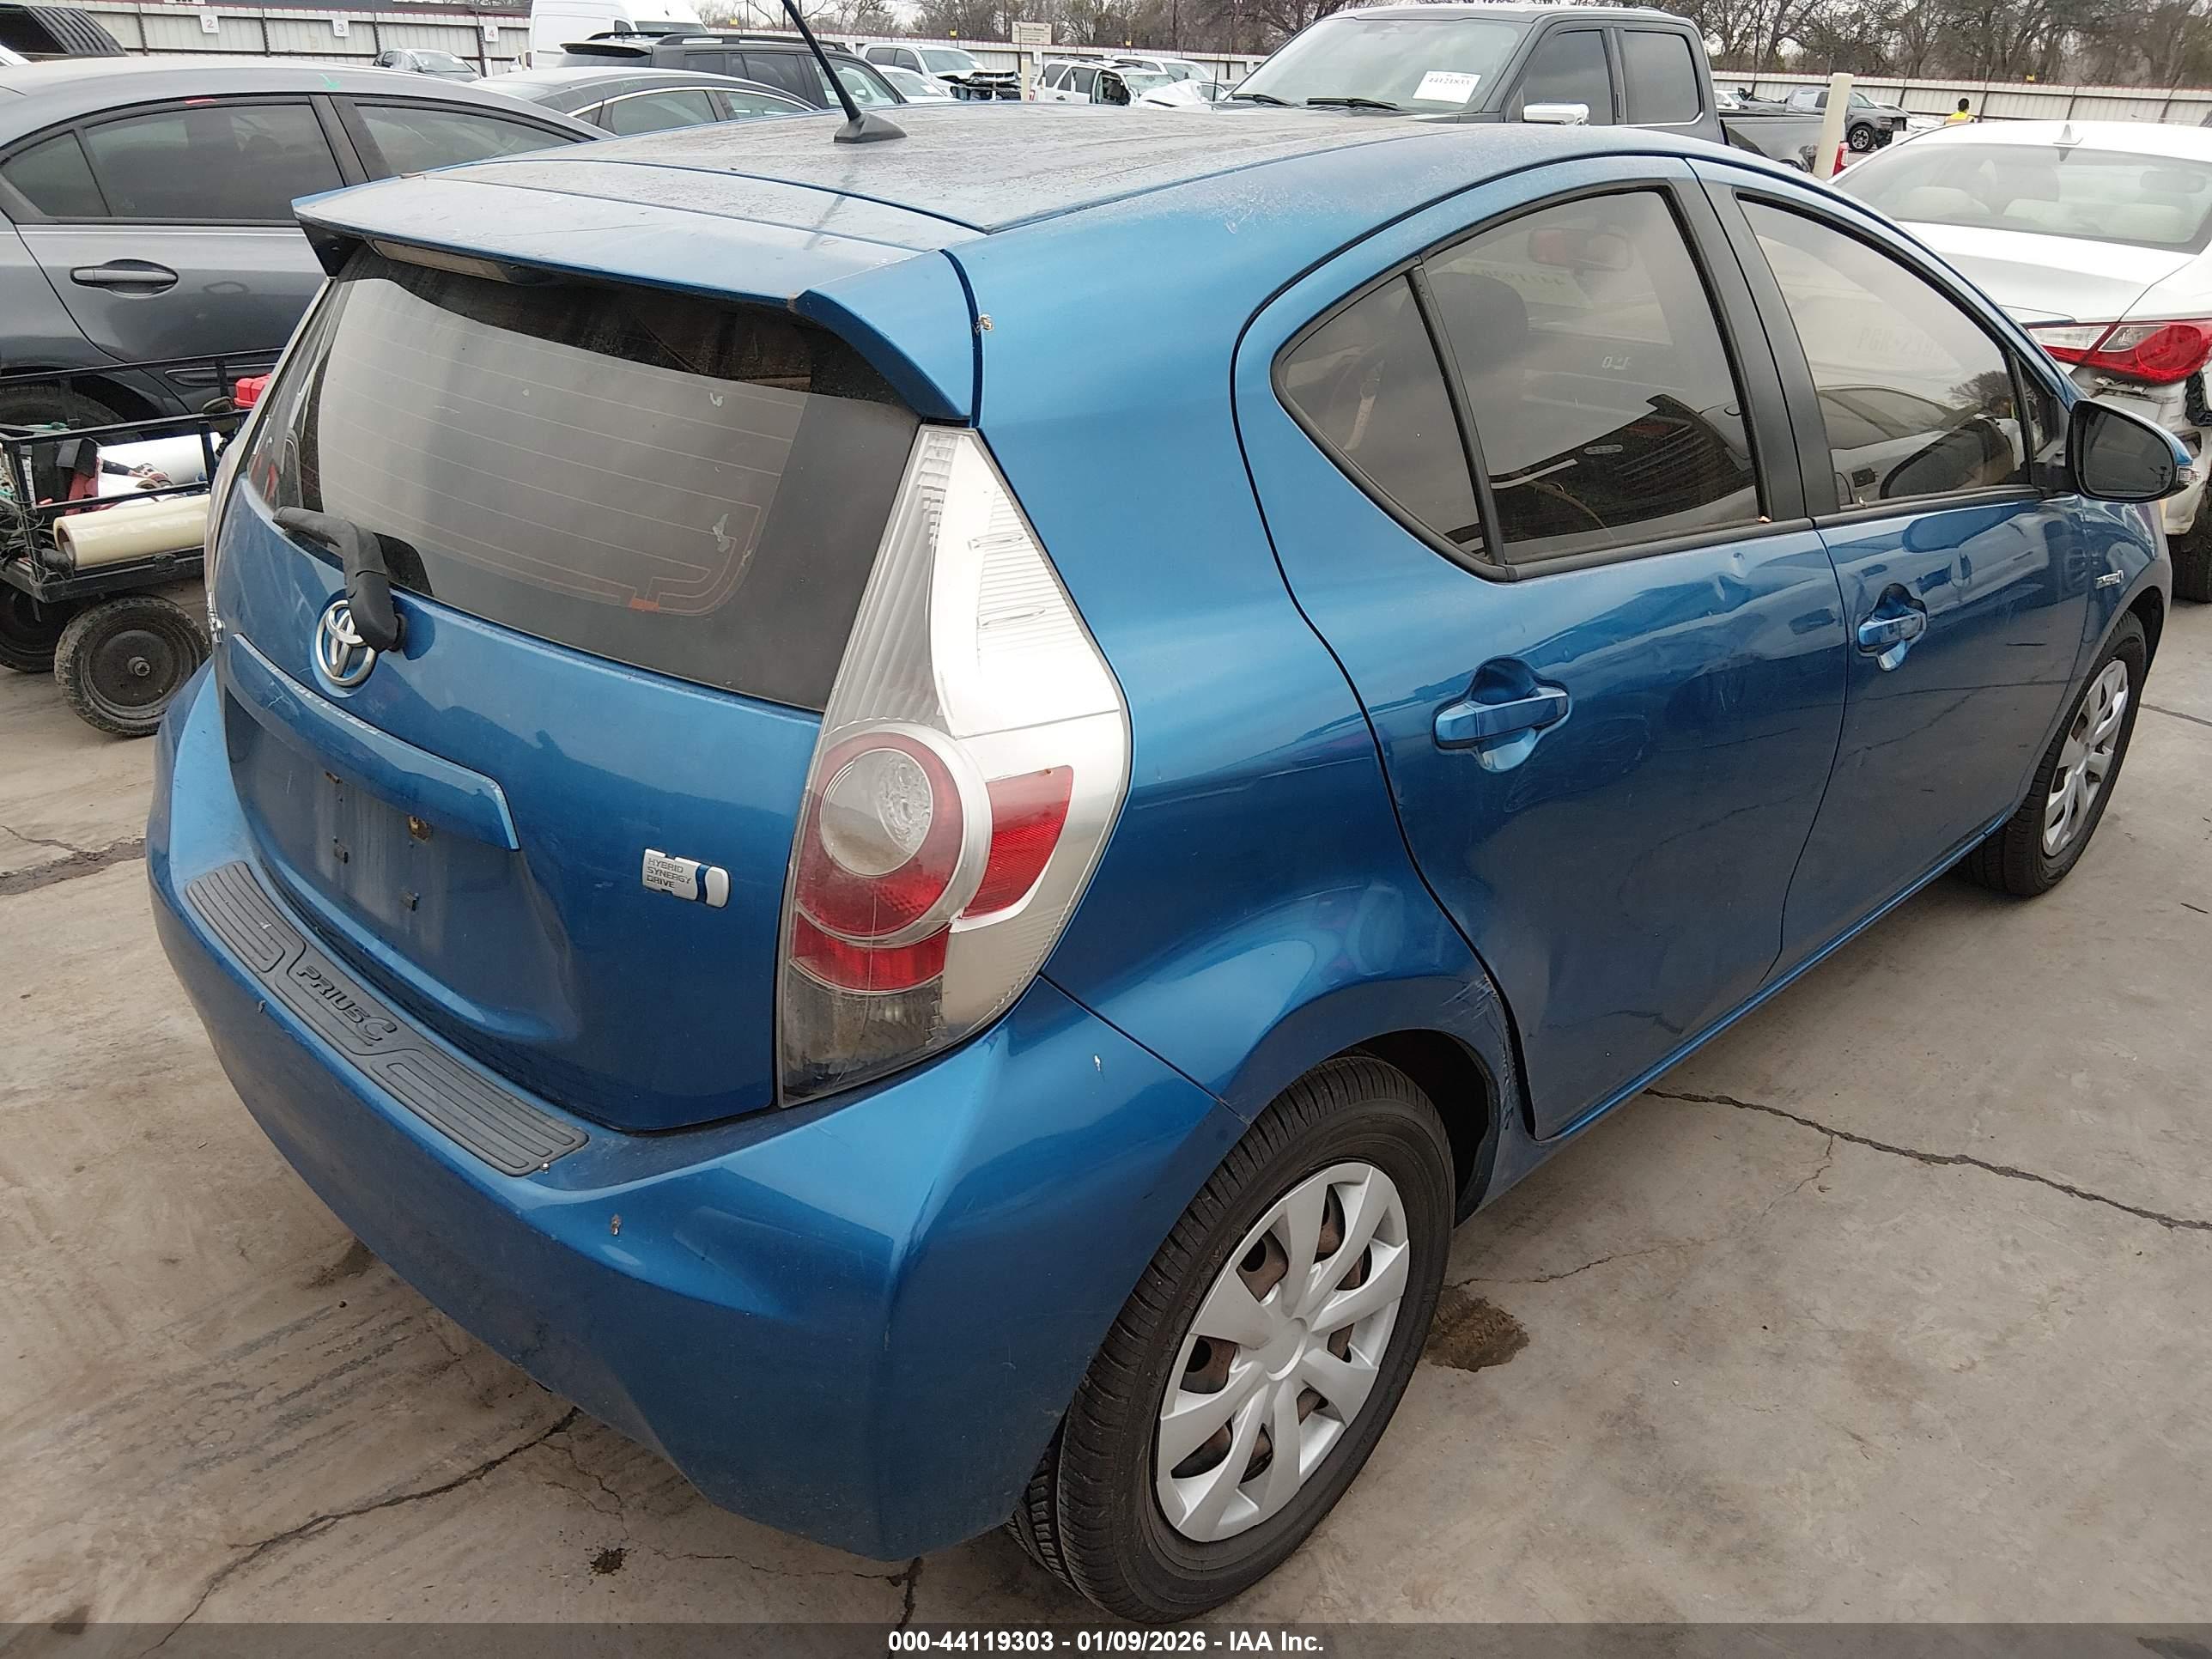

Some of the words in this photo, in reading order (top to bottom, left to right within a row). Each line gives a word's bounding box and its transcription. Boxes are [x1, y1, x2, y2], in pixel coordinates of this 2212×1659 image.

[206, 19, 215, 28] 2
[337, 23, 345, 33] 3
[488, 29, 495, 39] 4
[648, 857, 684, 873] HYBRID
[646, 874, 676, 889] DRIVE
[647, 866, 693, 884] SYNERGY
[296, 965, 371, 1024] PRIUS
